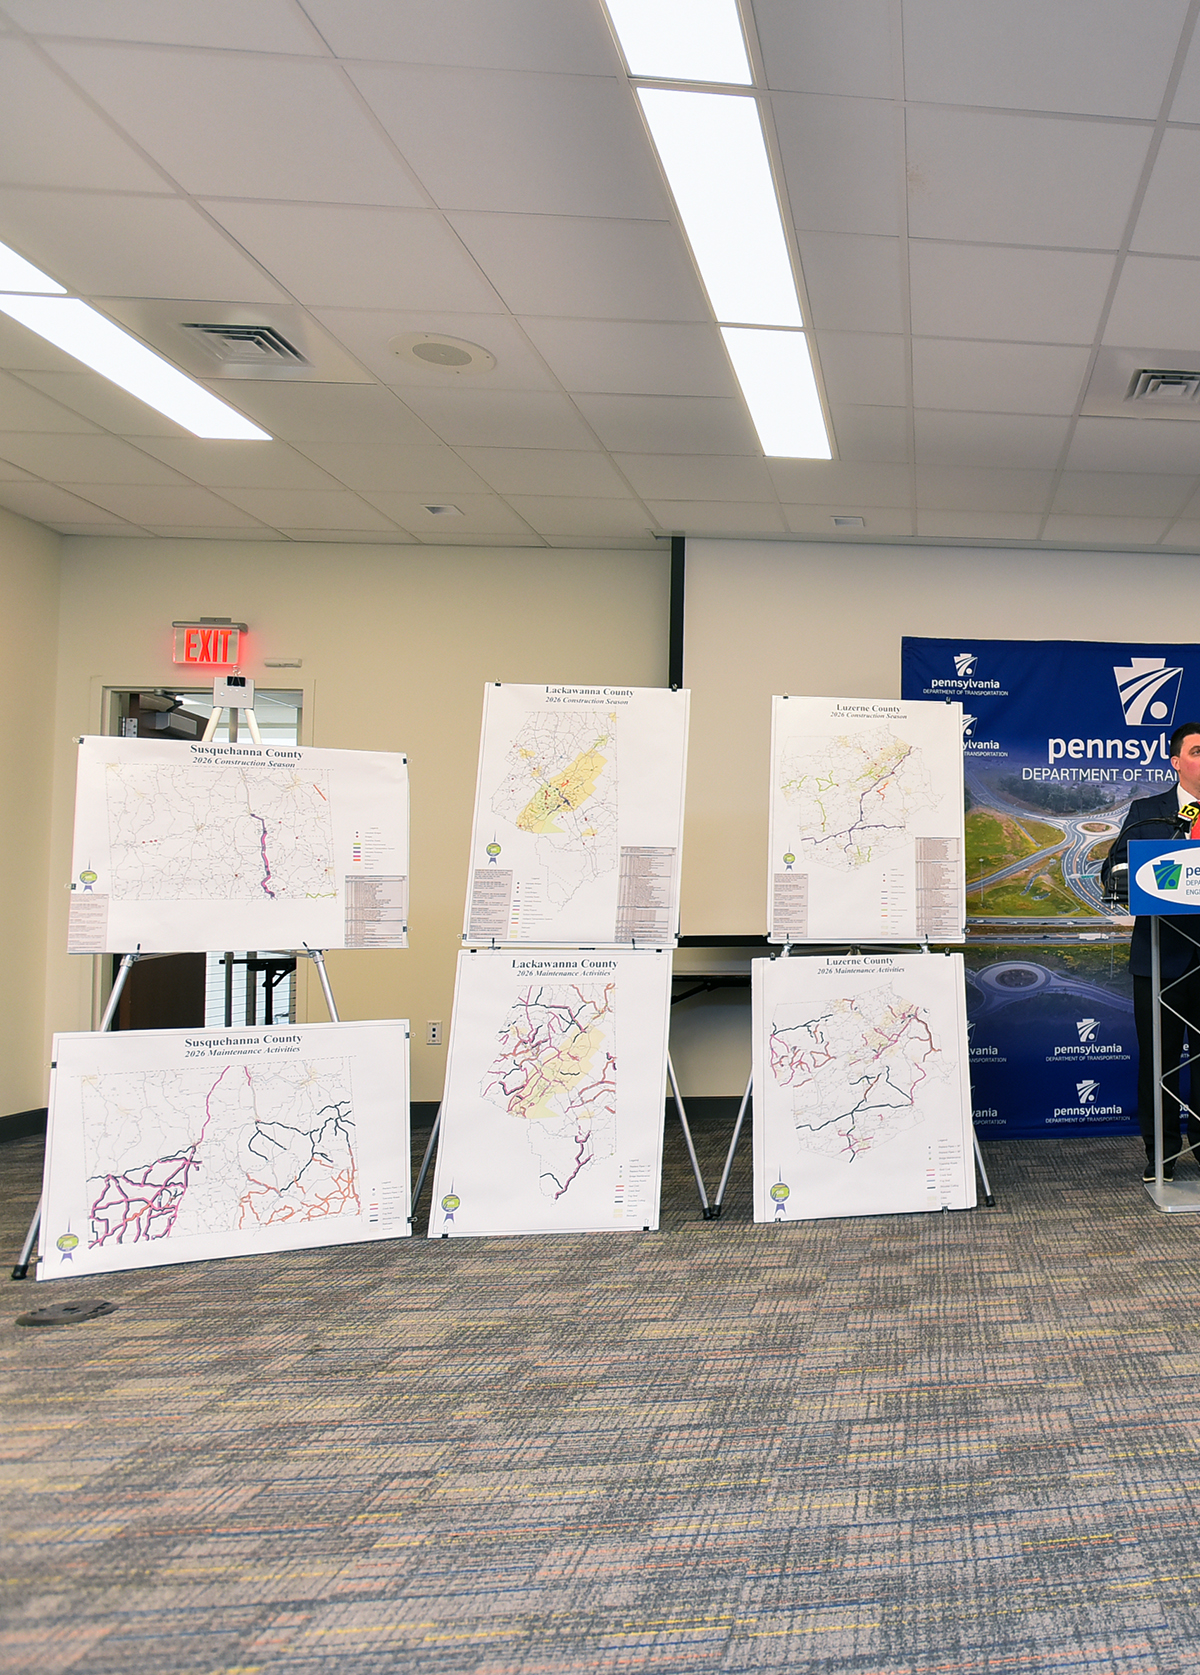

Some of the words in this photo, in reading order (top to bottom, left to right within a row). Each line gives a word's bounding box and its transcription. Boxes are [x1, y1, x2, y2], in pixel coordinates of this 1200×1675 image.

[185, 630, 232, 662] EXIT
[932, 678, 1000, 689] pennsylvania
[546, 686, 600, 695] Lackawanna
[603, 688, 634, 698] County
[872, 705, 901, 714] County
[190, 744, 262, 756] Susquehanna
[266, 749, 303, 760] County
[214, 758, 265, 767] Construction
[1022, 768, 1119, 781] DEPARTMENT
[1123, 768, 1142, 781] OF
[1182, 806, 1195, 816] 16
[512, 960, 577, 968] Lackawanna
[581, 959, 618, 970] County
[863, 957, 894, 966] County
[184, 1037, 260, 1048] Susquehanna
[263, 1034, 302, 1044] County
[1054, 1043, 1122, 1056] pennsylvania
[1054, 1105, 1122, 1118] pennsylvania
